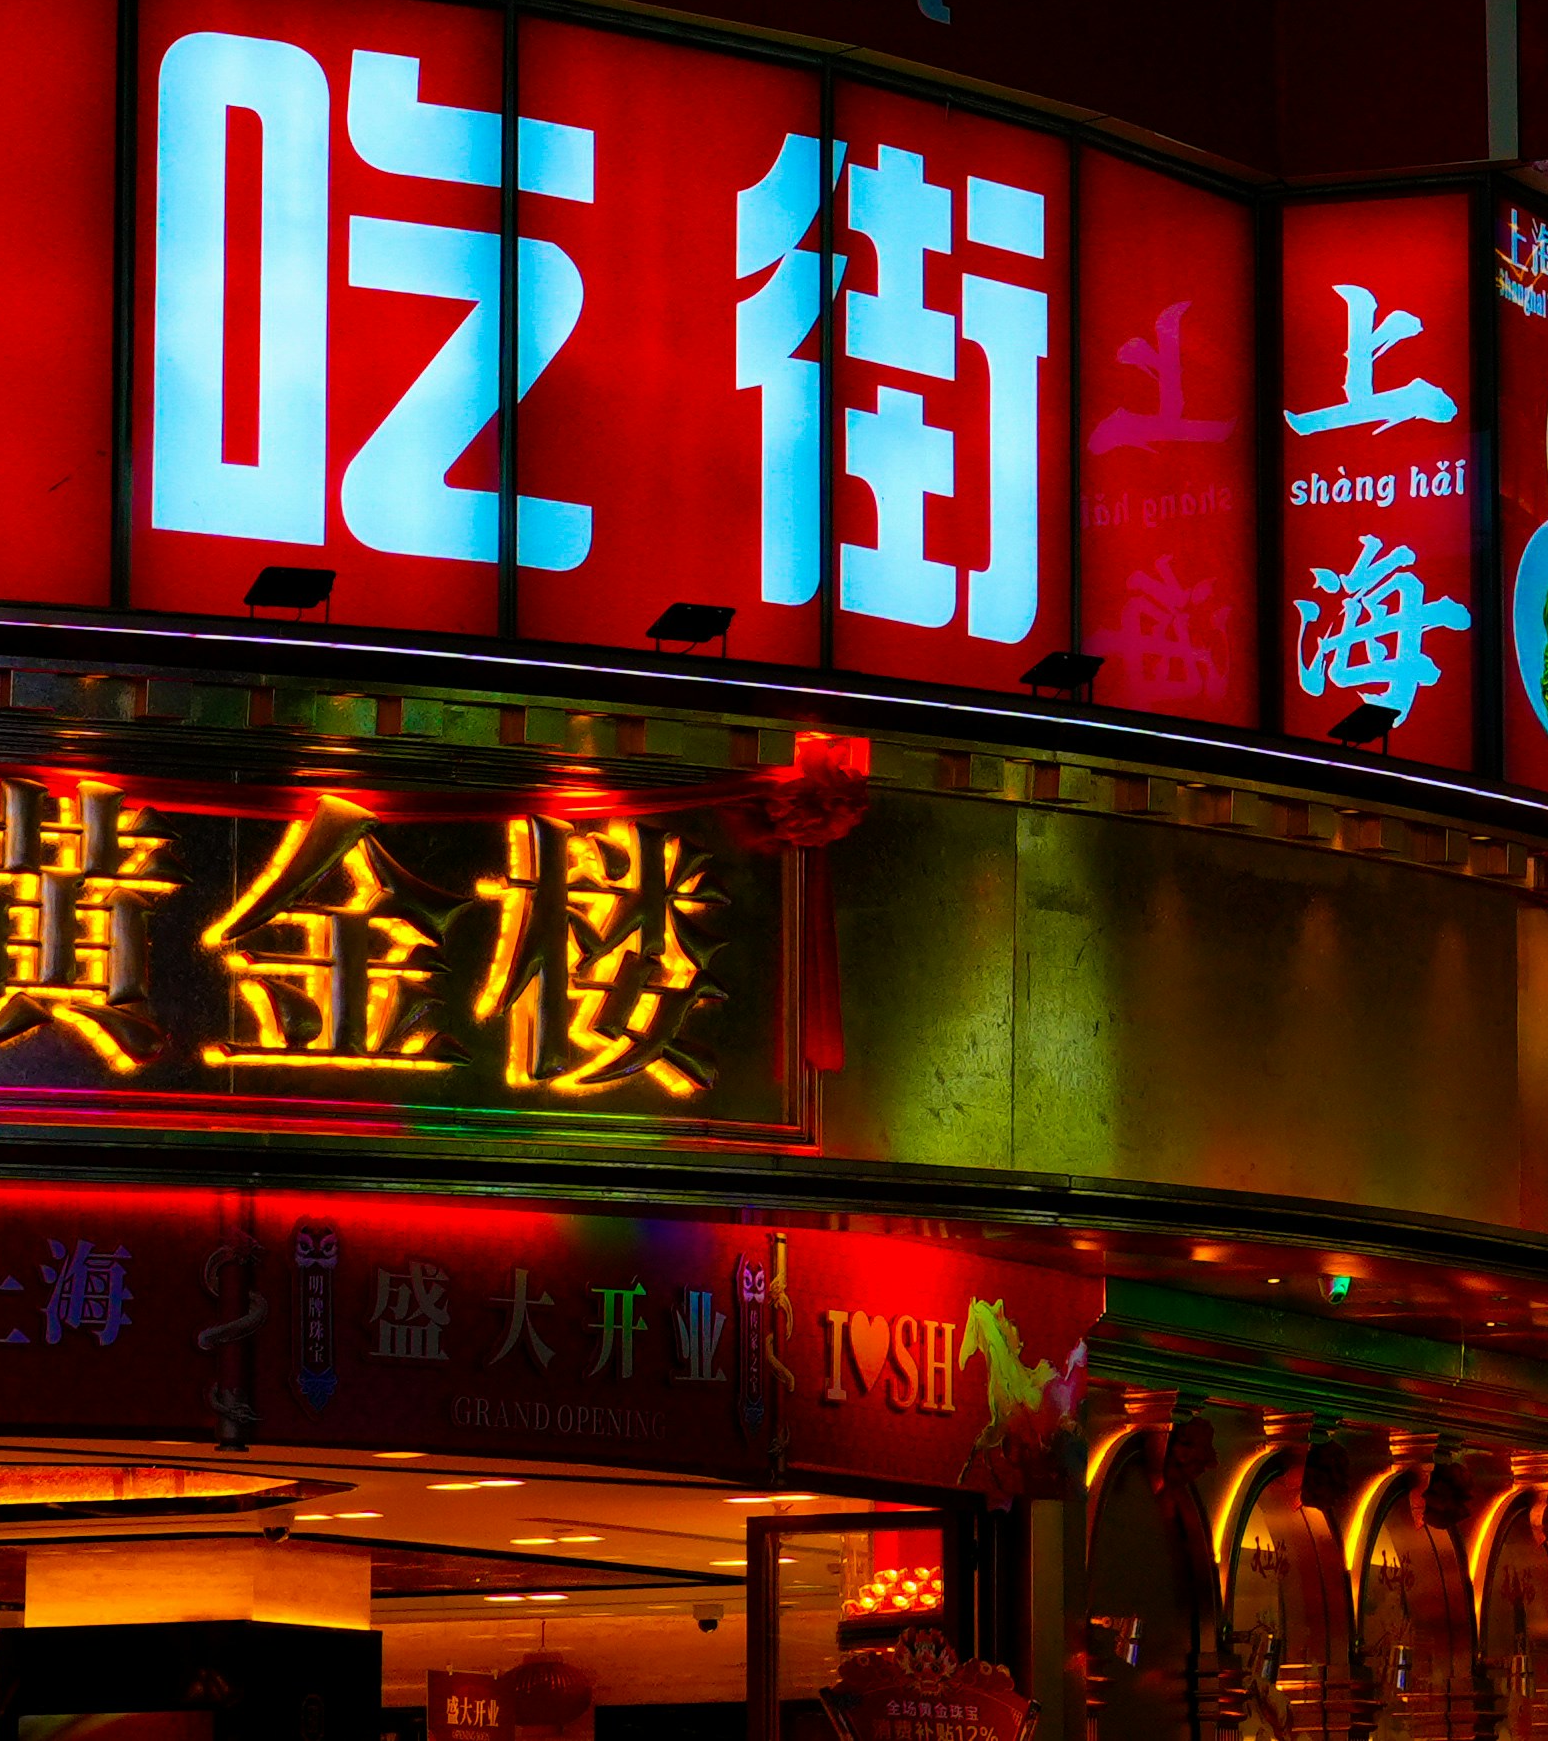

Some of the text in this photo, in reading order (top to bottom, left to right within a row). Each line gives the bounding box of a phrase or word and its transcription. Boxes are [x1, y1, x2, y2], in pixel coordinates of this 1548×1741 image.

[1283, 284, 1459, 437] 上
[1293, 534, 1472, 729] 海
[308, 1274, 325, 1364] 明牌珠宝
[367, 1261, 728, 1383] 盛大开业
[890, 1313, 958, 1415] SH
[453, 1395, 668, 1442] GRAND OPENING
